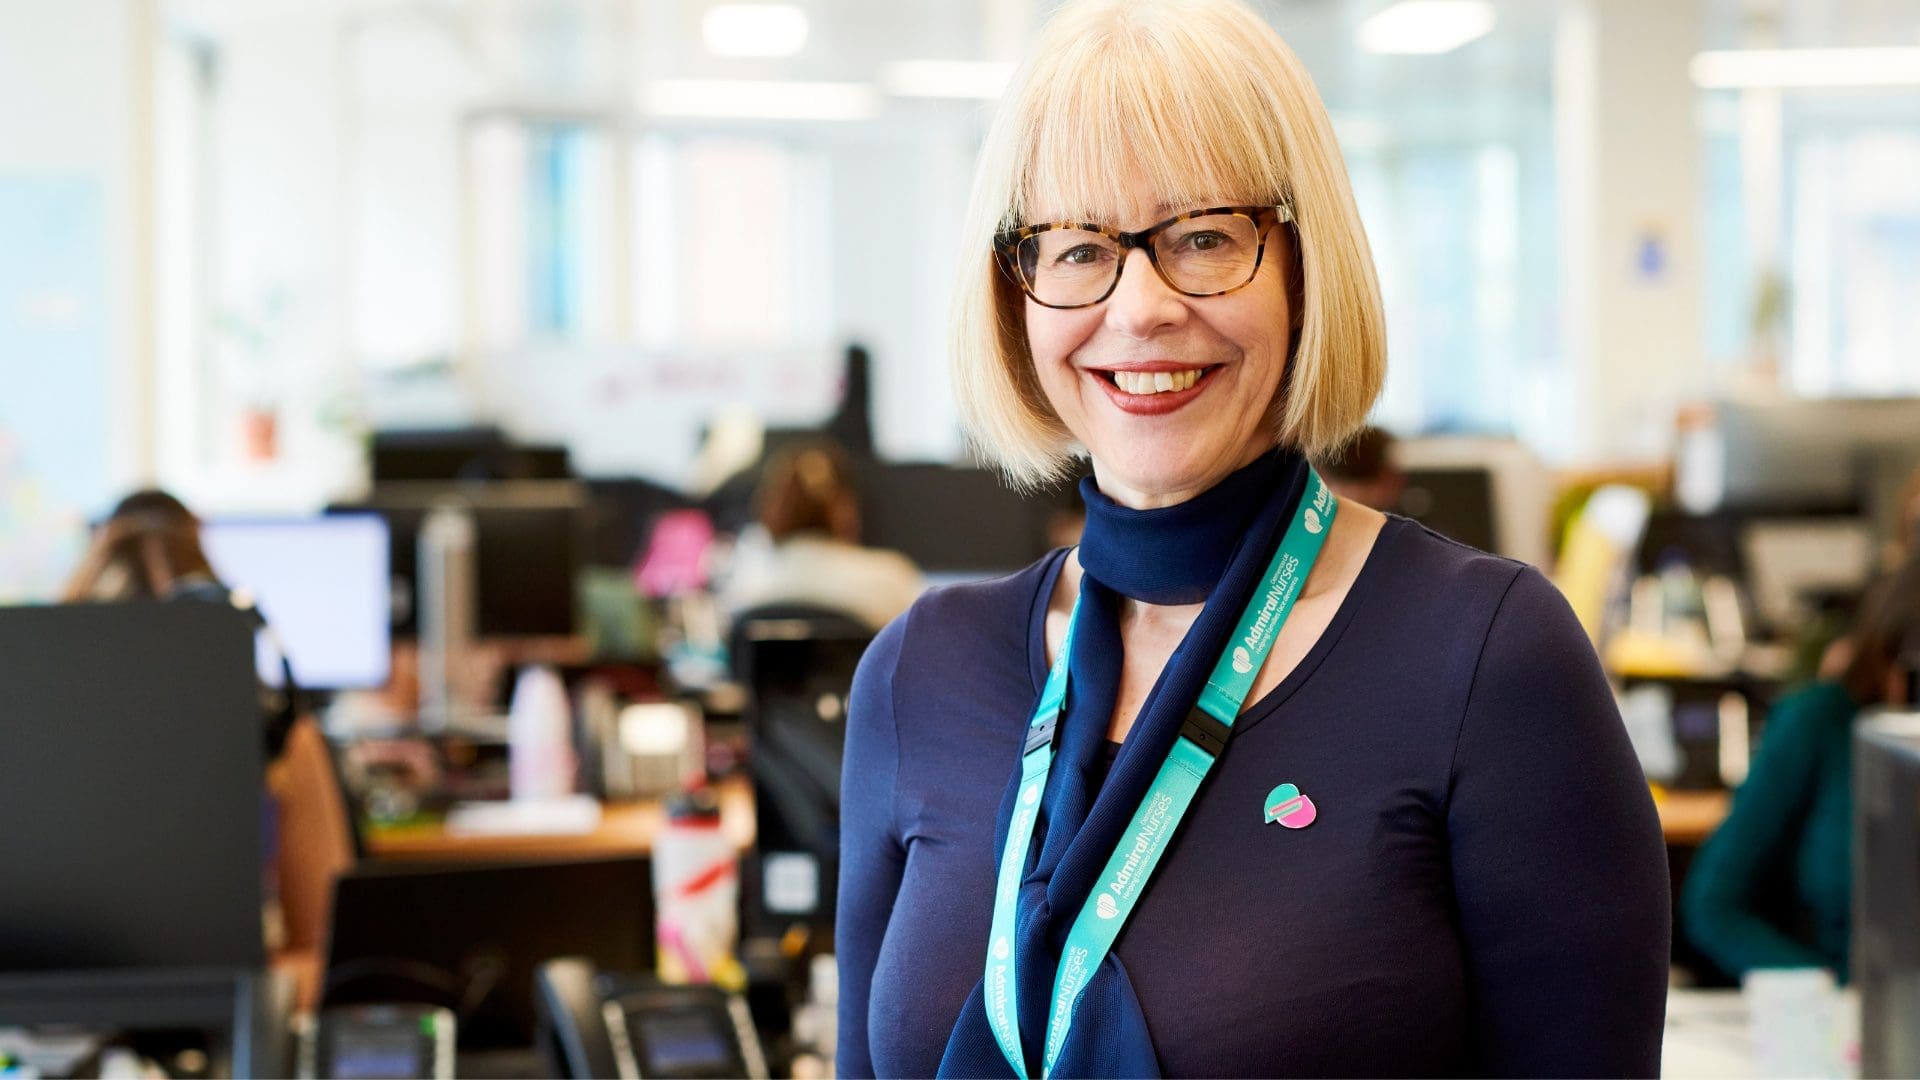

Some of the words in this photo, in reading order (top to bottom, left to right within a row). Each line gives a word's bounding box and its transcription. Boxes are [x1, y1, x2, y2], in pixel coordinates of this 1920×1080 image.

[1244, 556, 1299, 650] AdmiralNurses
[1110, 796, 1172, 895] AdmiralNurses
[1047, 948, 1088, 1064] AdmiralNurses
